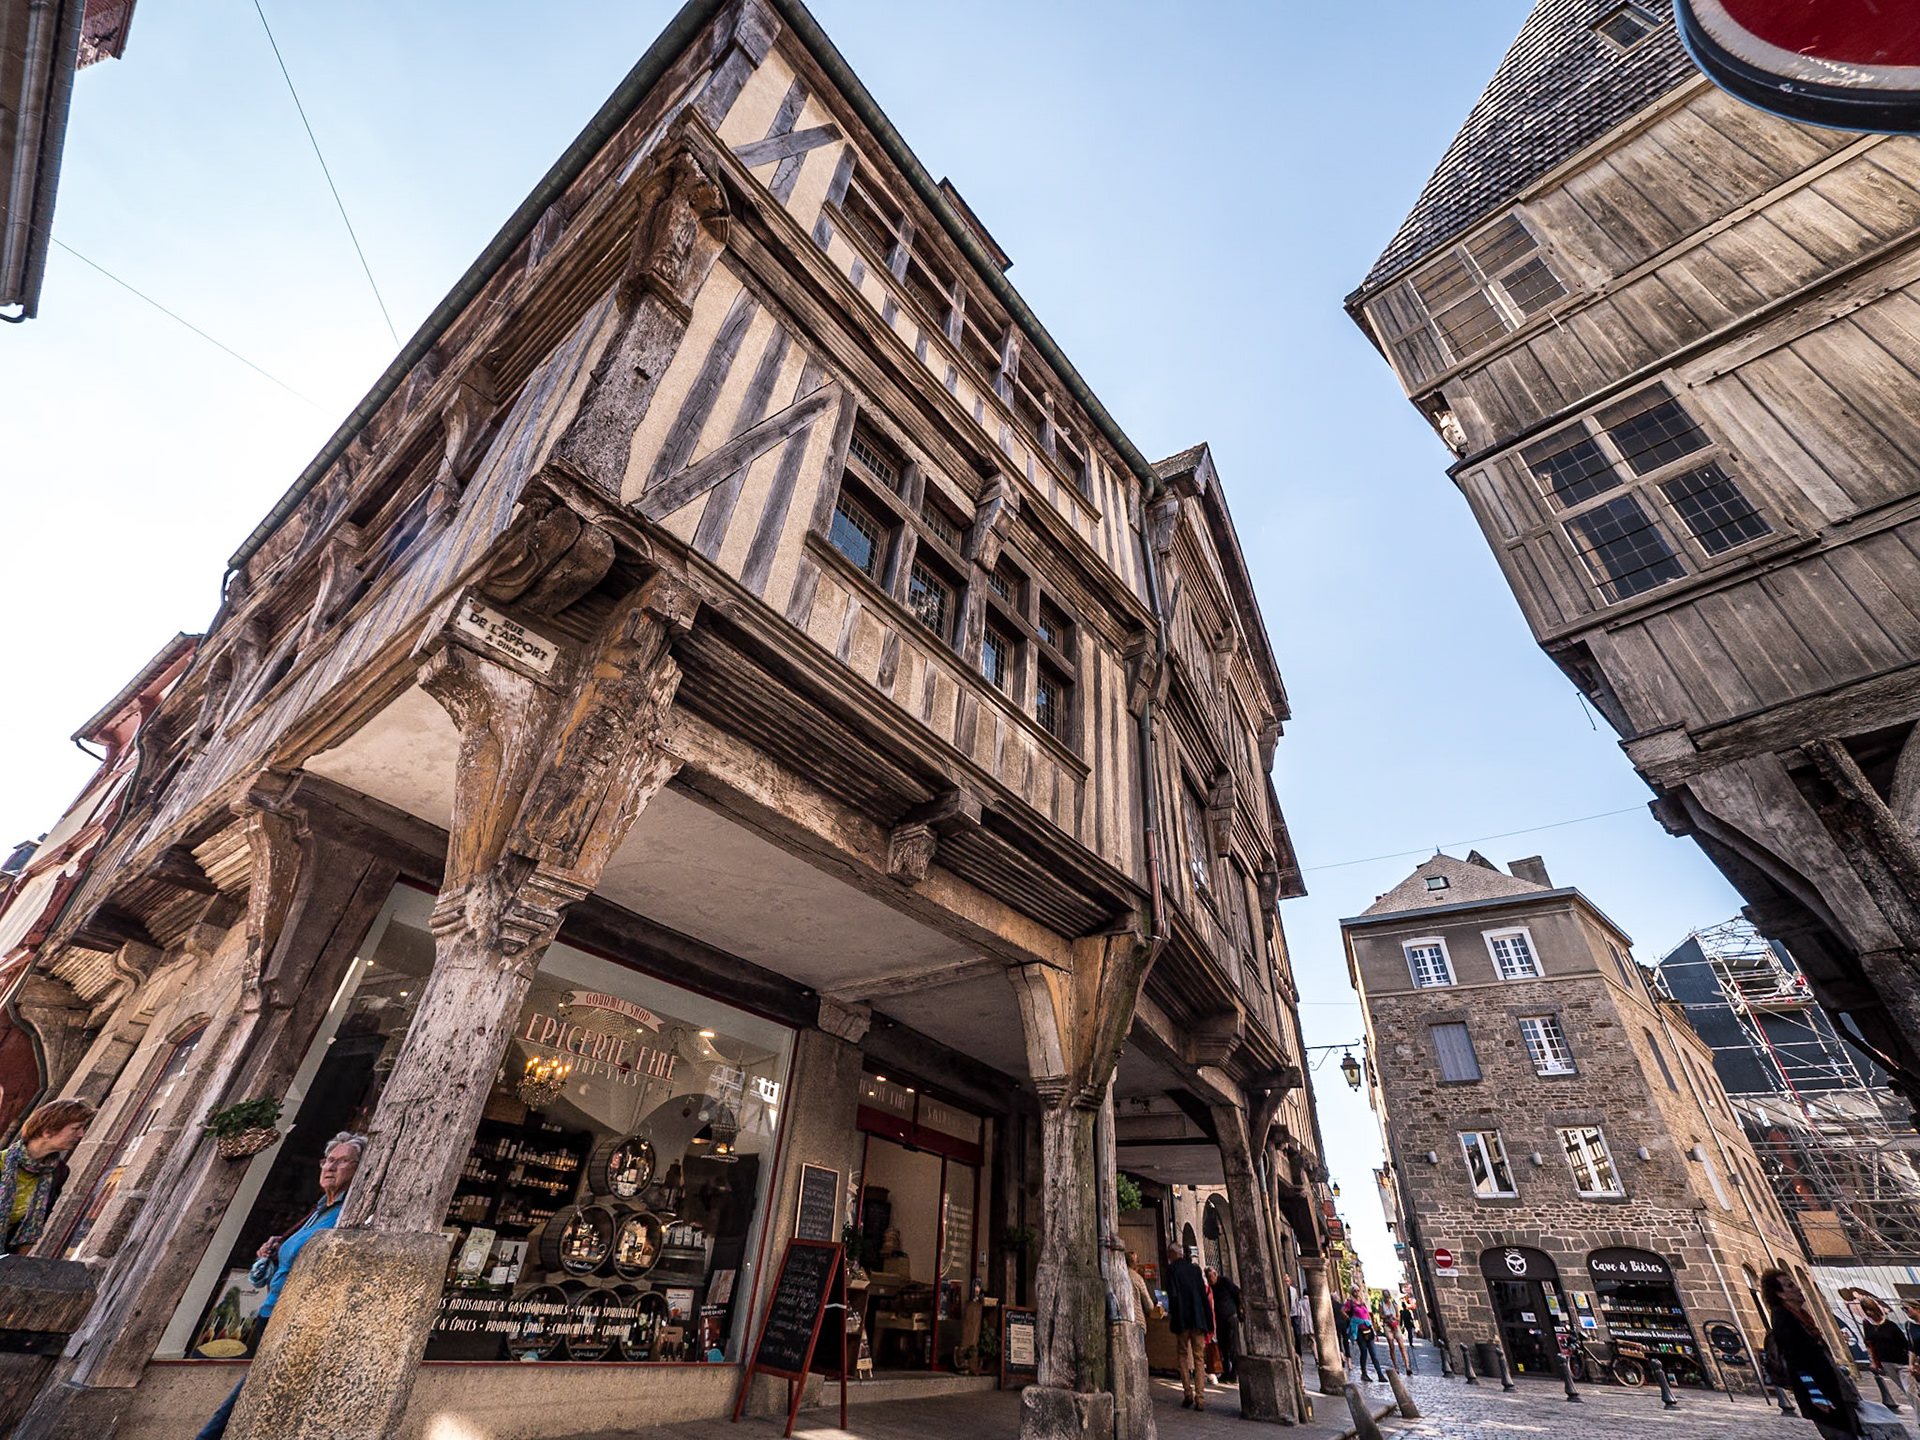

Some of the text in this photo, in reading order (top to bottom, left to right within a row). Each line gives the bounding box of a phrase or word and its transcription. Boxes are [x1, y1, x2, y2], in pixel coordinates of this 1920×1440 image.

[469, 612, 549, 661] DE L'APPORT
[501, 619, 525, 637] RUE
[497, 640, 523, 659] DINAN
[585, 992, 651, 1023] GOURMET SHOP
[524, 1012, 679, 1080] EPICERIE FINE
[556, 1052, 640, 1087] SAINT-YVES
[1591, 1259, 1663, 1273] Cave à Bières
[448, 1298, 498, 1312] ARTISANAUX
[498, 1300, 508, 1312] &
[439, 1318, 448, 1331] &
[449, 1315, 478, 1331] ÉPICES
[484, 1320, 521, 1333] PRODUITS
